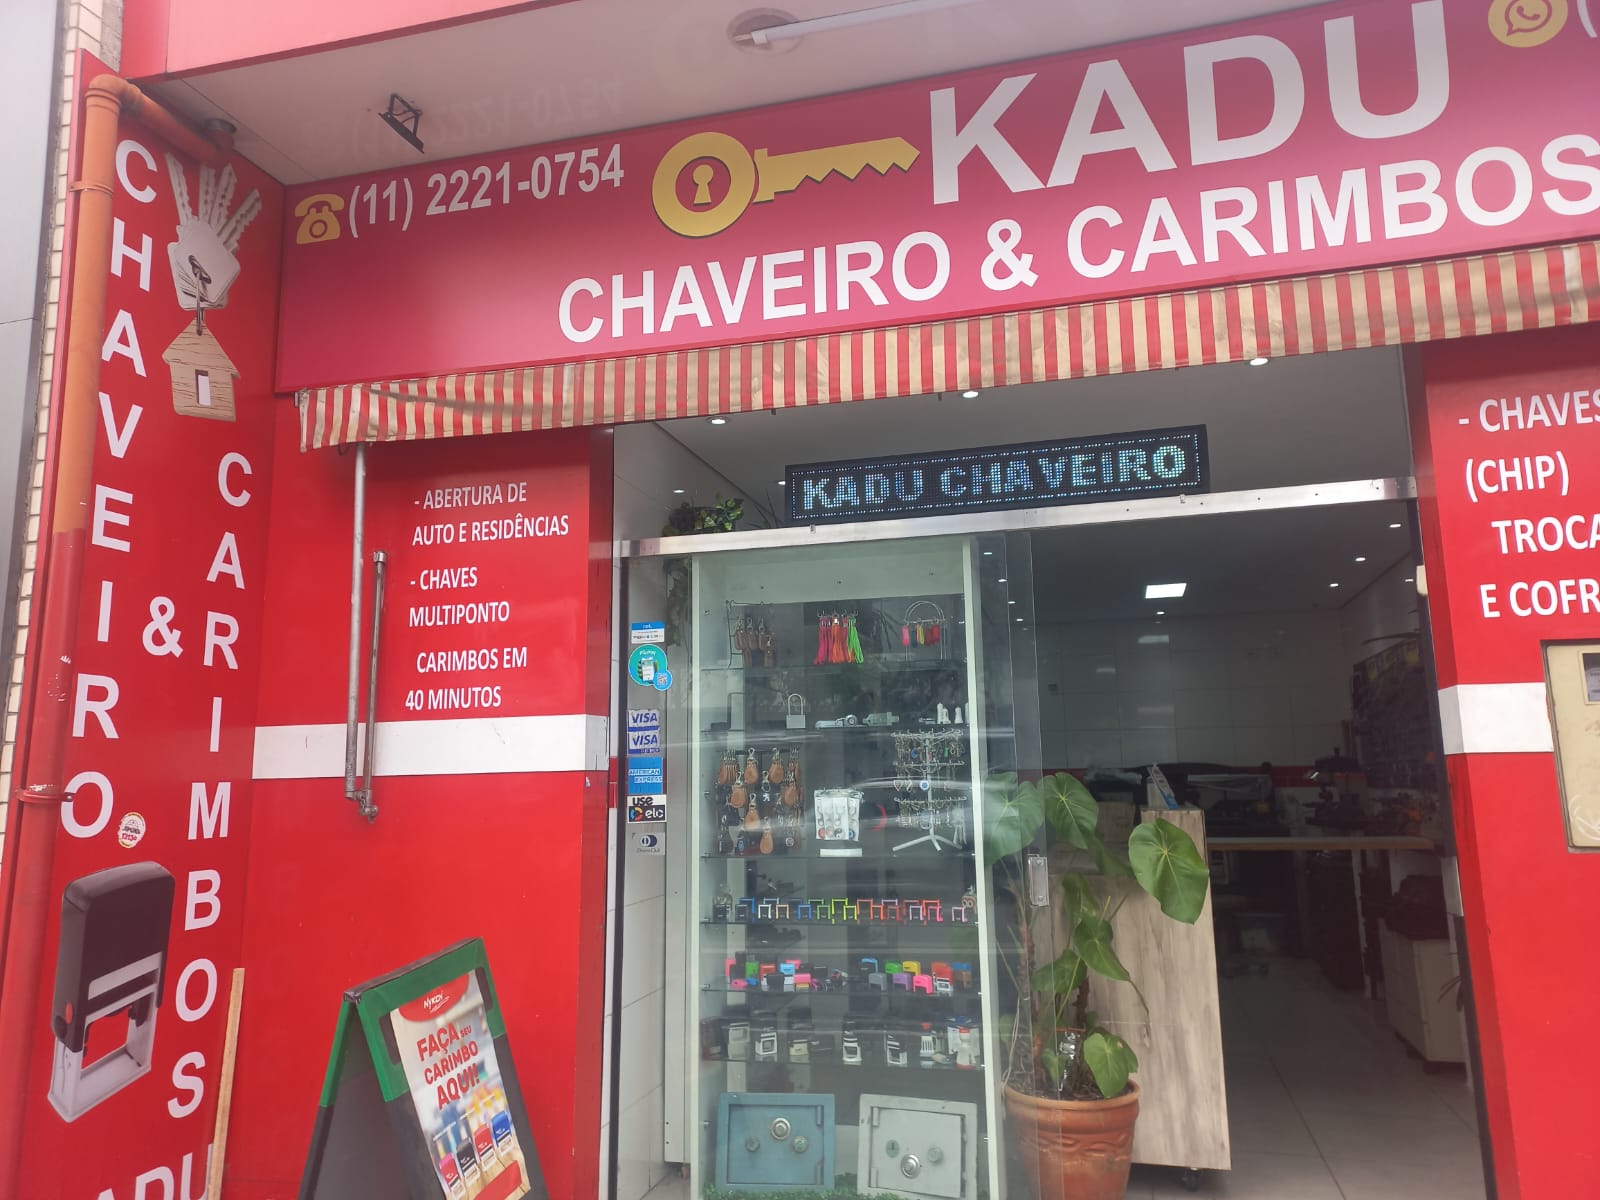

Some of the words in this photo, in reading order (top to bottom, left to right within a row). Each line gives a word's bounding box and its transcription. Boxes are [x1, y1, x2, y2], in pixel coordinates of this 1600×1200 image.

[929, 0, 1451, 205] KADU
[349, 178, 414, 238] (11)
[425, 143, 625, 216] 2221-0754
[558, 230, 951, 344] CHAVEIRO
[980, 218, 1039, 291] &
[1066, 134, 1600, 279] CARIMBOS
[61, 139, 158, 838] CHAVEIRO
[802, 470, 923, 511] KADU
[940, 445, 1187, 497] CHAVEIRO
[1465, 450, 1570, 503] (CHIP)
[423, 484, 503, 510] ABERTURA
[507, 482, 528, 503] DE
[412, 523, 454, 546] AUTO
[459, 522, 467, 543] E
[471, 512, 569, 542] RESIDÊNCIAS
[420, 566, 478, 590] CHAVES
[409, 600, 510, 628] MULTIPONTO
[1480, 583, 1501, 619] E
[142, 596, 183, 658] &
[416, 648, 499, 673] CARIMBOS
[503, 646, 528, 669] EM
[405, 689, 424, 711] 40
[428, 685, 502, 710] MINUTOS
[631, 712, 658, 724] VISA
[632, 734, 658, 746] VISA
[167, 450, 252, 1119] CARIMBOS
[632, 796, 653, 806] use
[416, 1022, 460, 1061] FAÇA
[459, 1025, 472, 1038] SEU
[424, 1040, 479, 1085] CARIMBO
